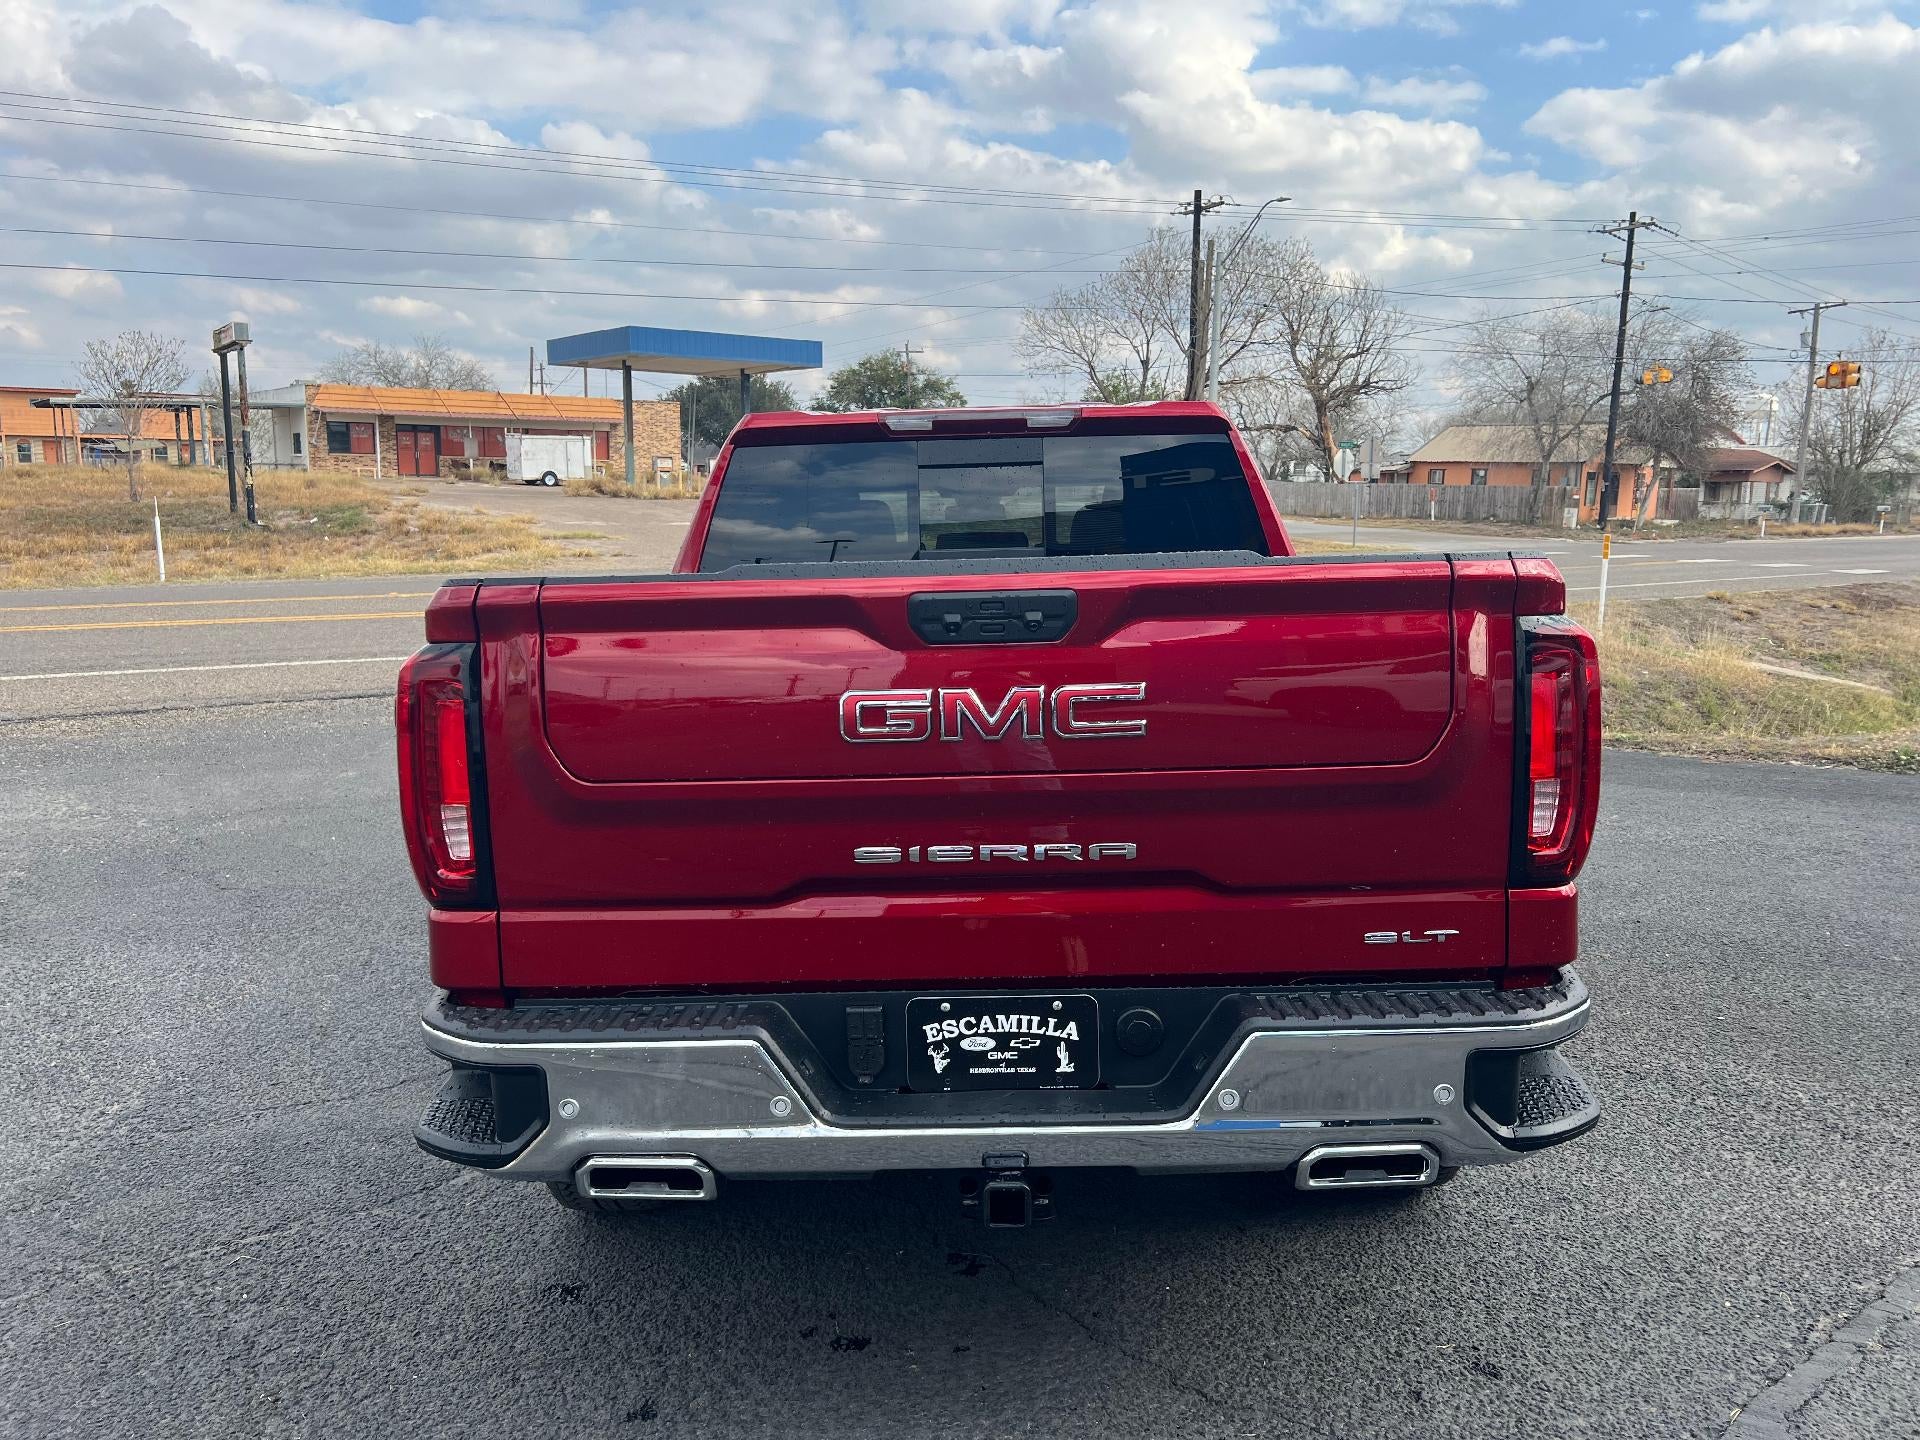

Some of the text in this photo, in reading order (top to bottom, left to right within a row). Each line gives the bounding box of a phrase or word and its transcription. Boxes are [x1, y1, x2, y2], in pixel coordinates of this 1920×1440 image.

[839, 682, 1147, 742] GMC
[853, 842, 1137, 863] SIERRA
[1363, 929, 1460, 943] SLT
[922, 1014, 1079, 1043] ESCAMILLA
[966, 1038, 989, 1049] Ford
[987, 1051, 1018, 1060] GMC
[1017, 1066, 1037, 1074] TEXAS
